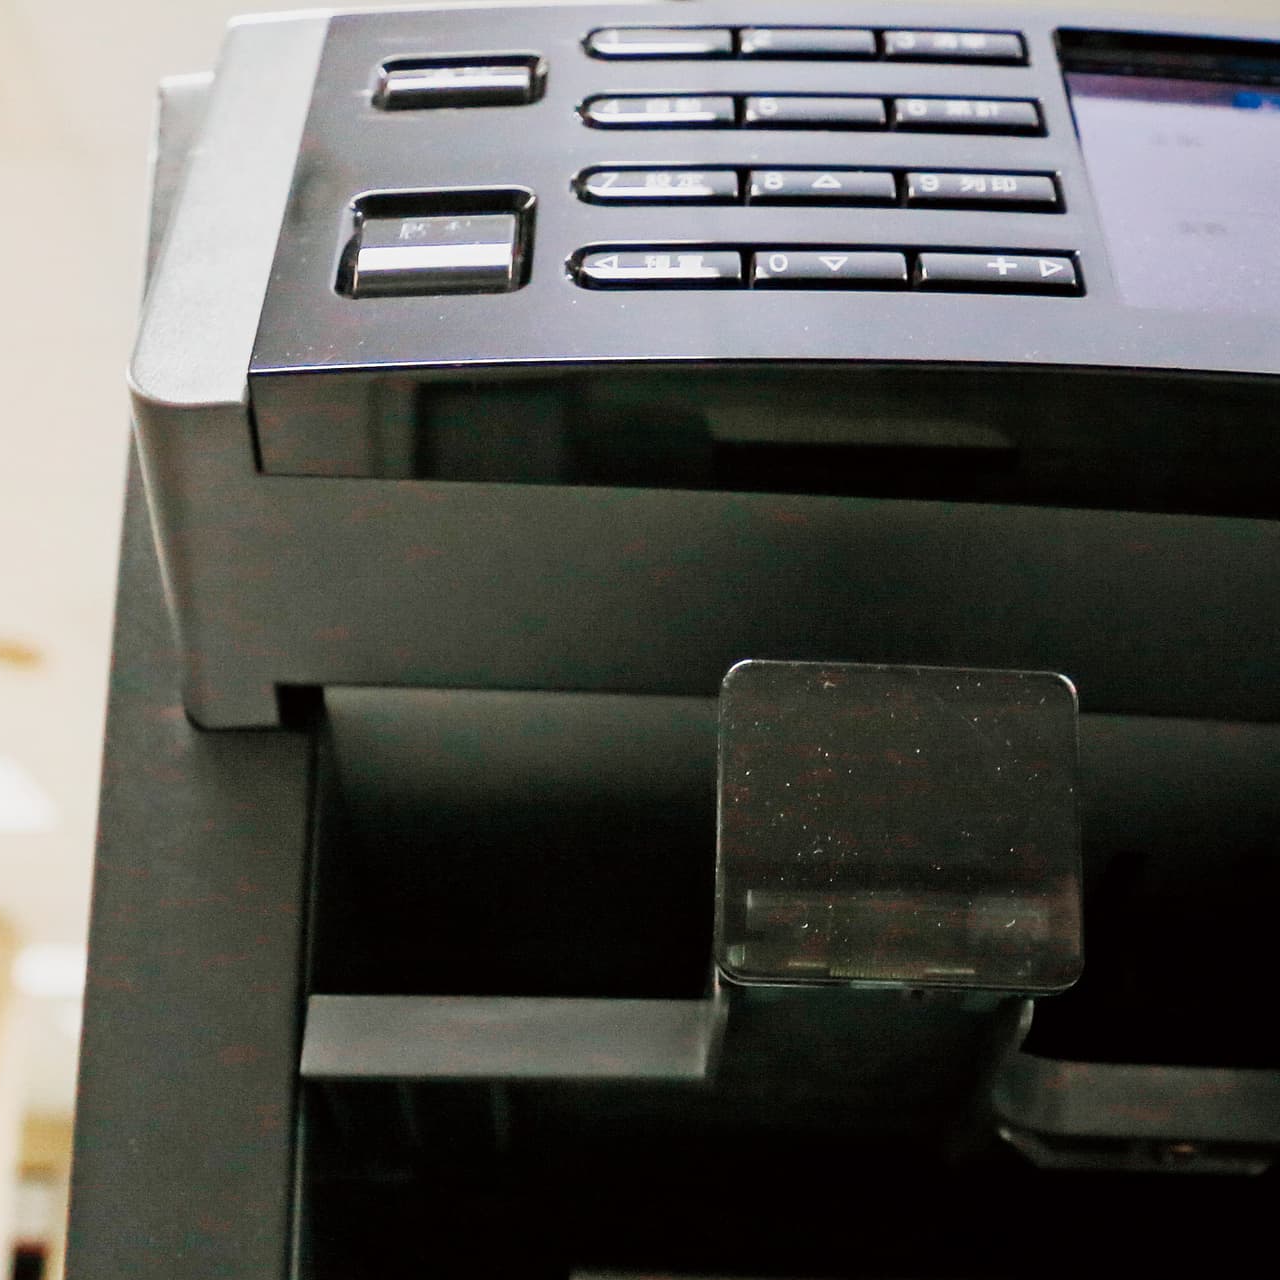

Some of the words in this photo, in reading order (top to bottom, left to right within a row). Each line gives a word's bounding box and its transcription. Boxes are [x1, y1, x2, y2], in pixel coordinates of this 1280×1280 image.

[764, 172, 783, 189] 8
[921, 175, 940, 192] 9
[960, 176, 1017, 193] 列印
